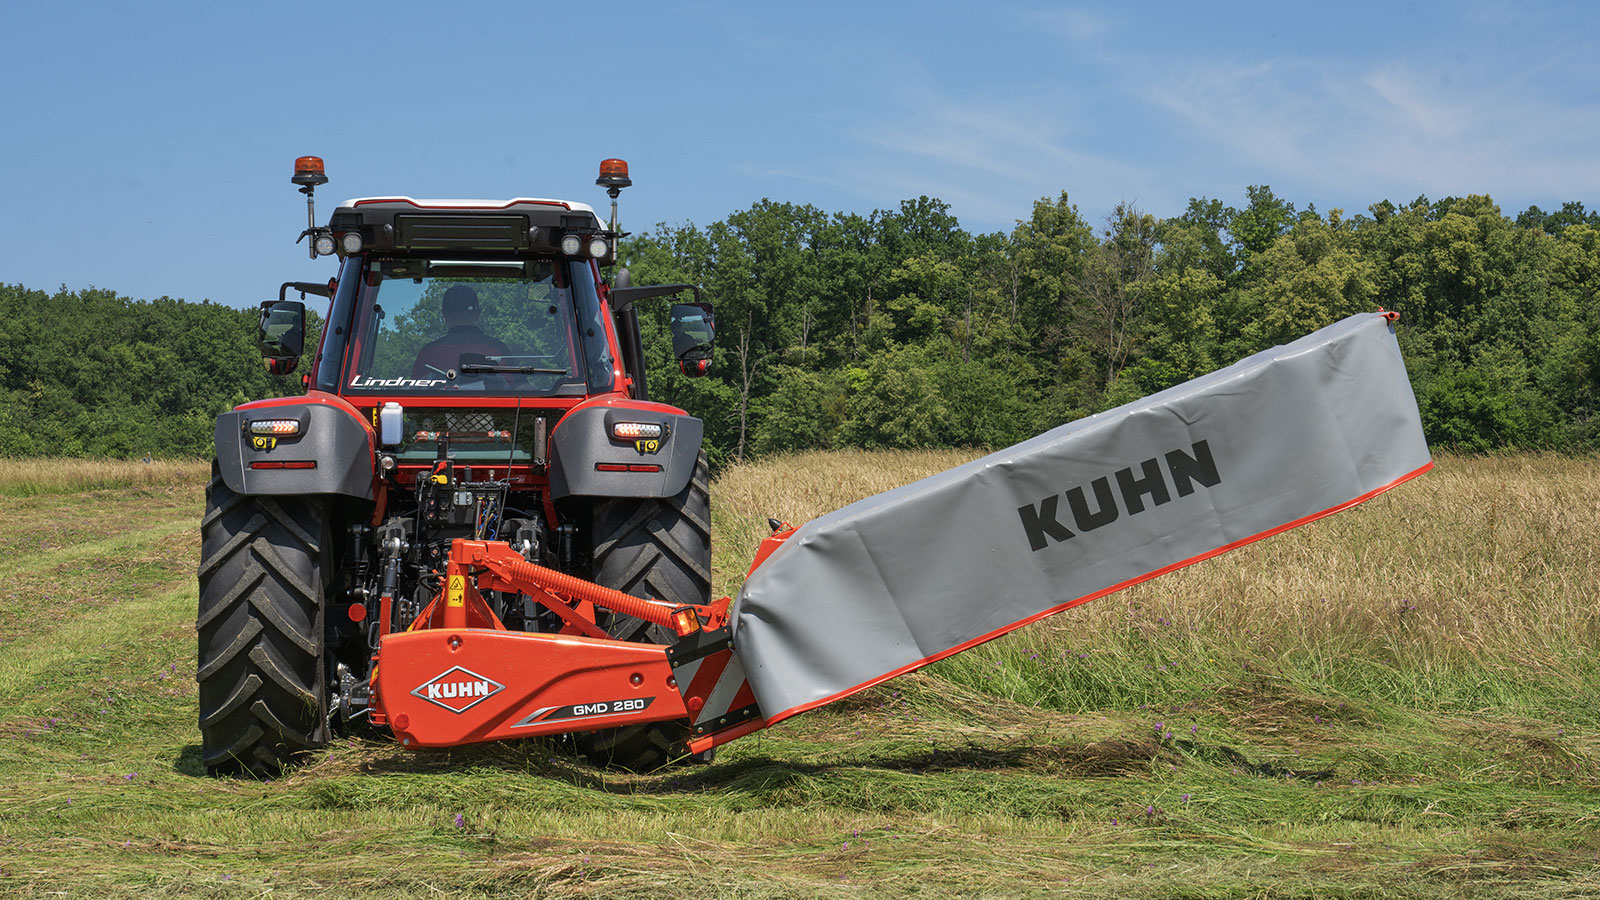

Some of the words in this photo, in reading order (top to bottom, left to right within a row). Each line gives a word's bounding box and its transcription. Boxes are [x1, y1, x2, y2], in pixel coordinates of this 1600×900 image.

[350, 374, 447, 387] Lindner
[1017, 439, 1222, 552] KUHN
[428, 681, 489, 699] KUHN
[573, 703, 608, 716] GMD
[613, 699, 645, 712] 280
